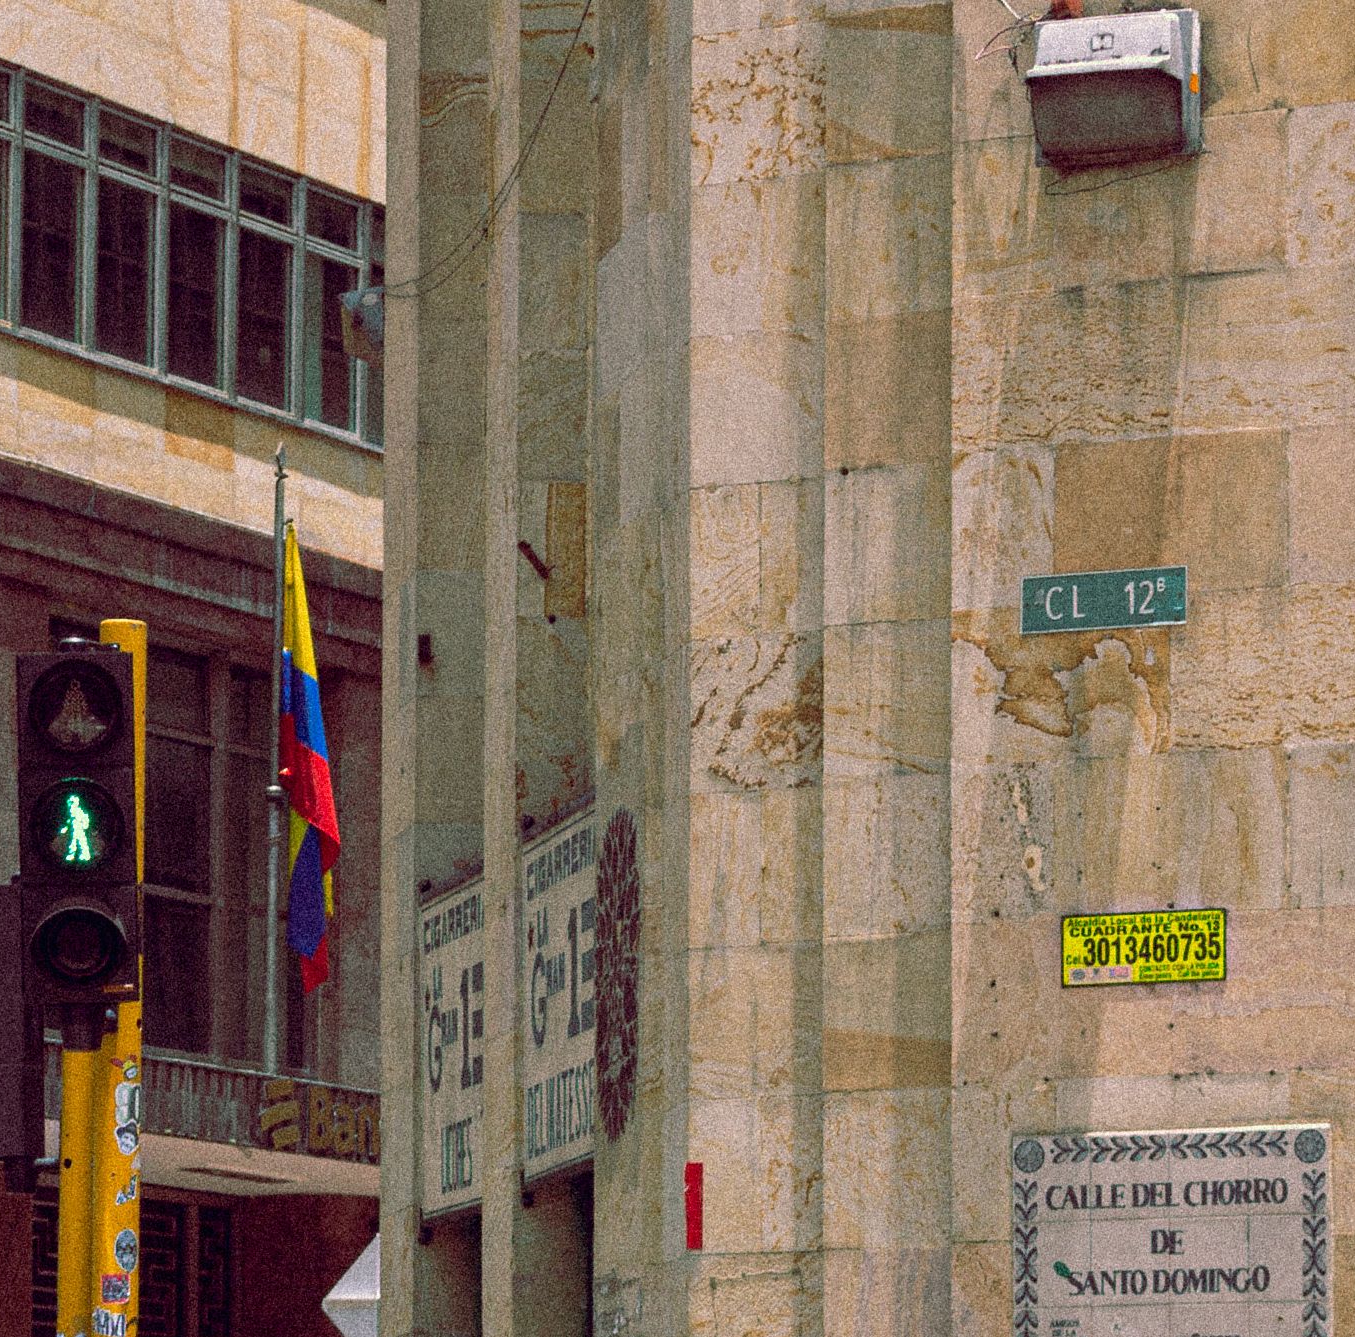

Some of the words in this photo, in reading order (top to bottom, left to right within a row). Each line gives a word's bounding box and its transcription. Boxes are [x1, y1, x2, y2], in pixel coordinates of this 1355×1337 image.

[1045, 584, 1087, 621] CL
[1069, 921, 1172, 938] CUADRANTE
[1206, 920, 1220, 931] 13
[1083, 932, 1221, 967] 3013460735
[1045, 1184, 1126, 1211] CALLE
[1132, 1181, 1180, 1208] DEL
[1183, 1177, 1289, 1206] CHORRO
[1150, 1229, 1185, 1255] DE
[1066, 1269, 1147, 1296] SANTO
[1152, 1265, 1271, 1296] DOMINGO
